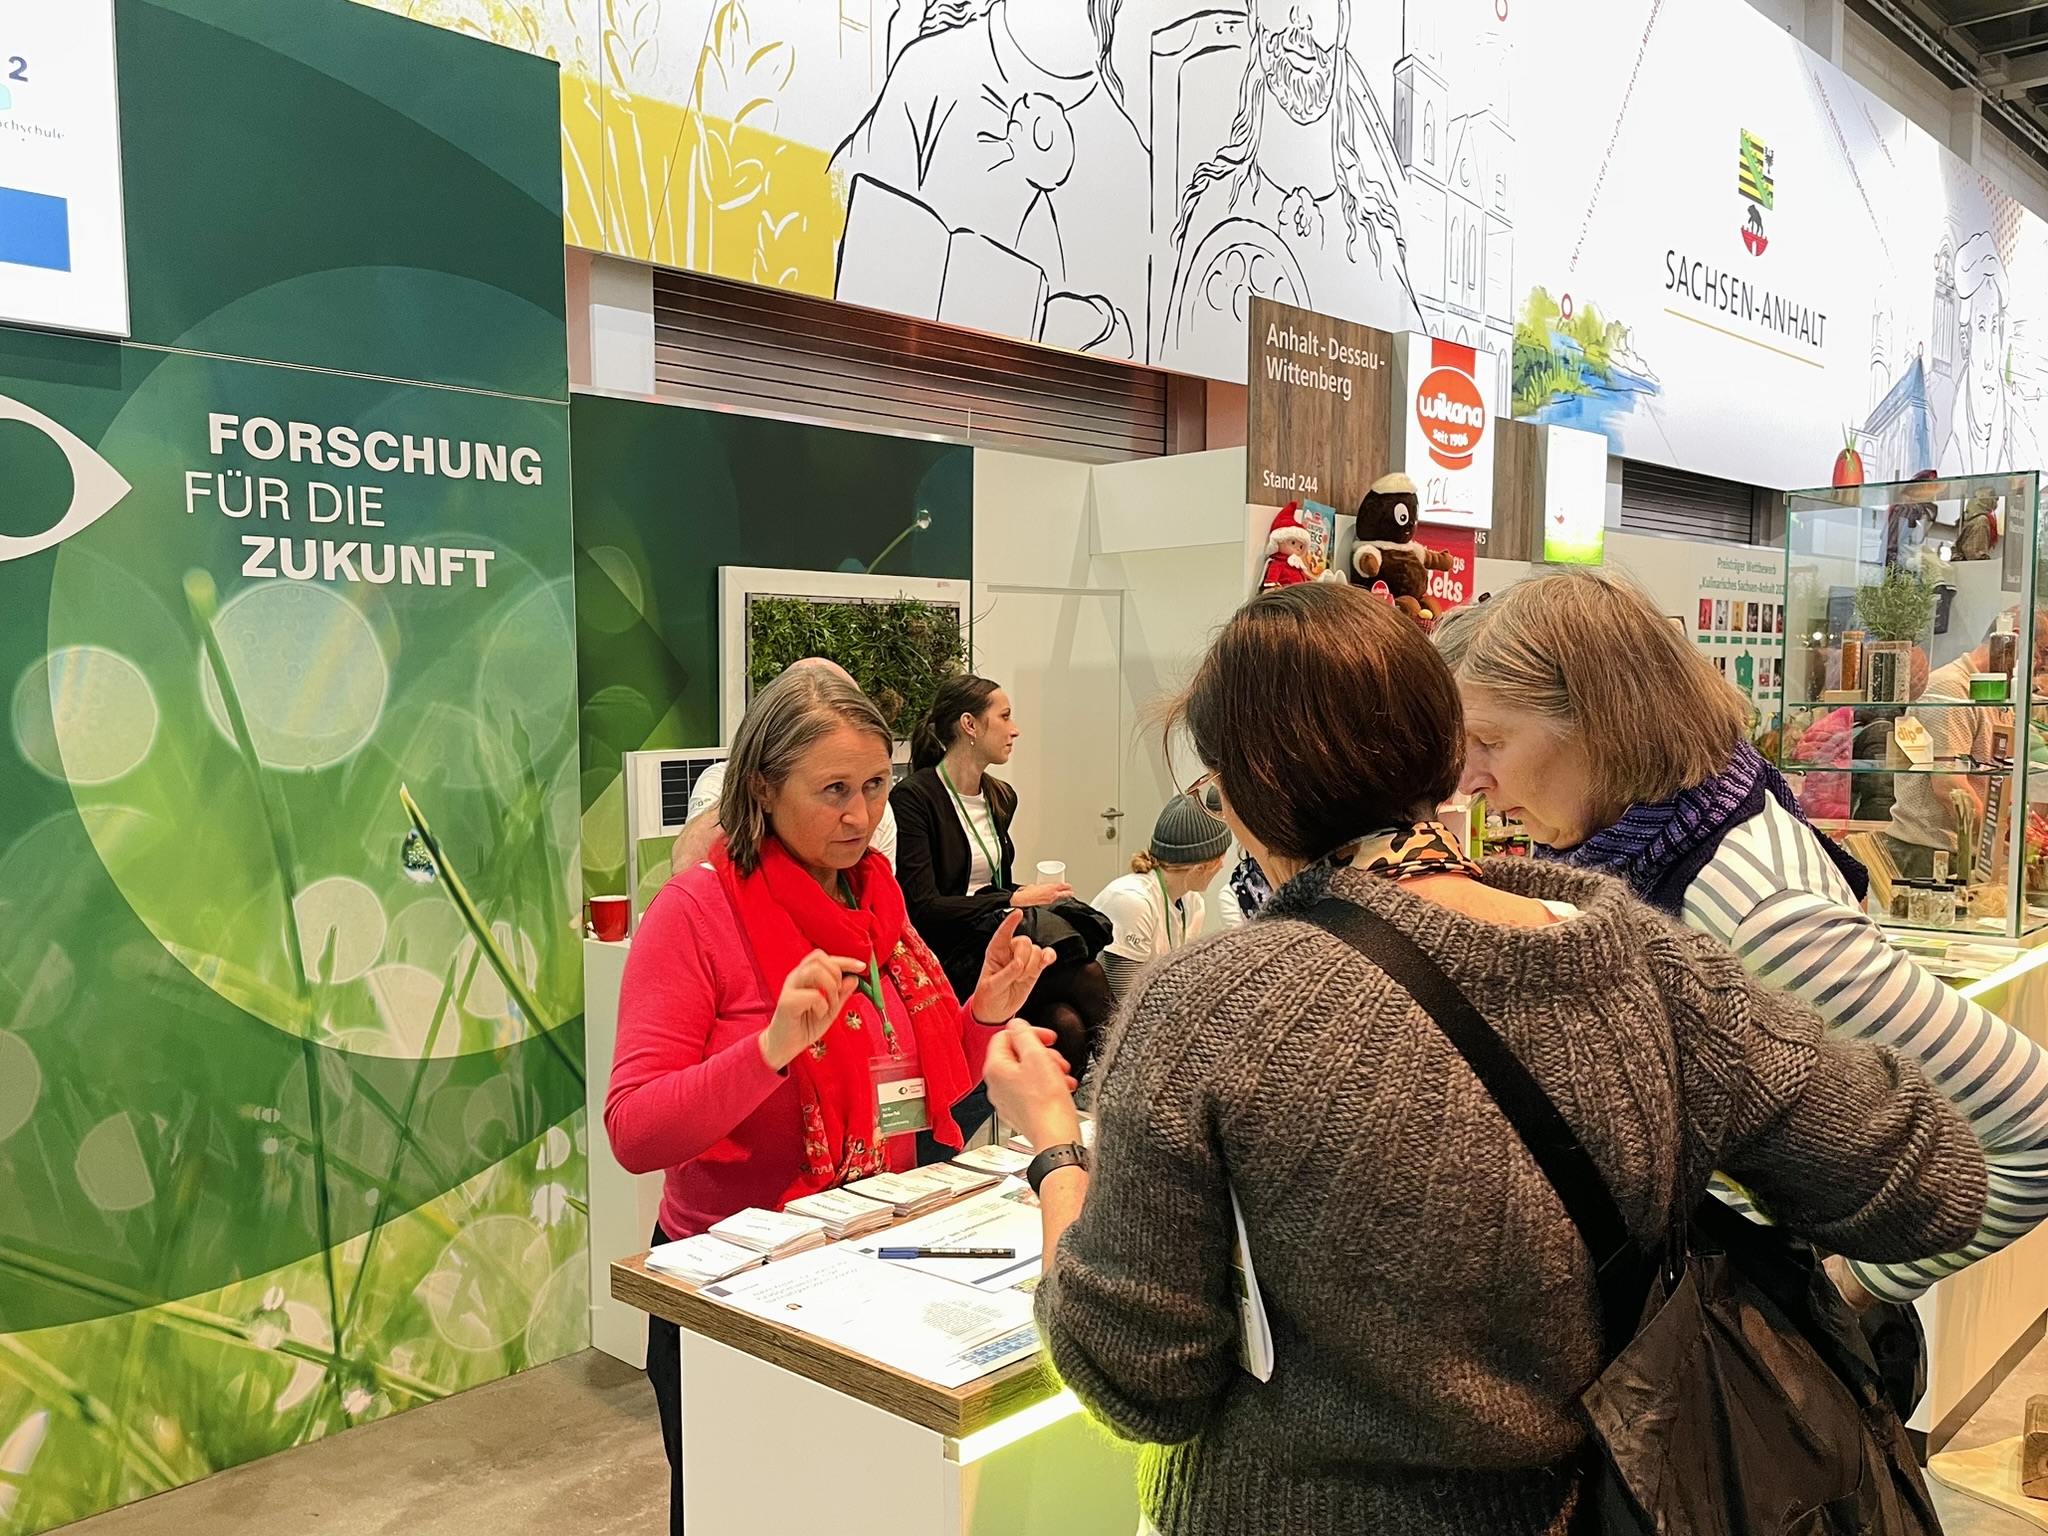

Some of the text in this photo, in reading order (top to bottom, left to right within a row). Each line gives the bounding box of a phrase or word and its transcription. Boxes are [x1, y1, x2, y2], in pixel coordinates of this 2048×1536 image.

[1665, 249, 1827, 348] SACHSEN-ANHALT
[1265, 355, 1352, 402] Wittenberg
[1419, 391, 1483, 429] wikana
[208, 412, 543, 486] FORSCHUNG
[184, 469, 386, 528] FÜR DIE
[1263, 469, 1319, 494] Stand 244
[240, 534, 495, 588] ZUKUNFT
[1897, 727, 1917, 743] dip
[1126, 933, 1141, 945] dip
